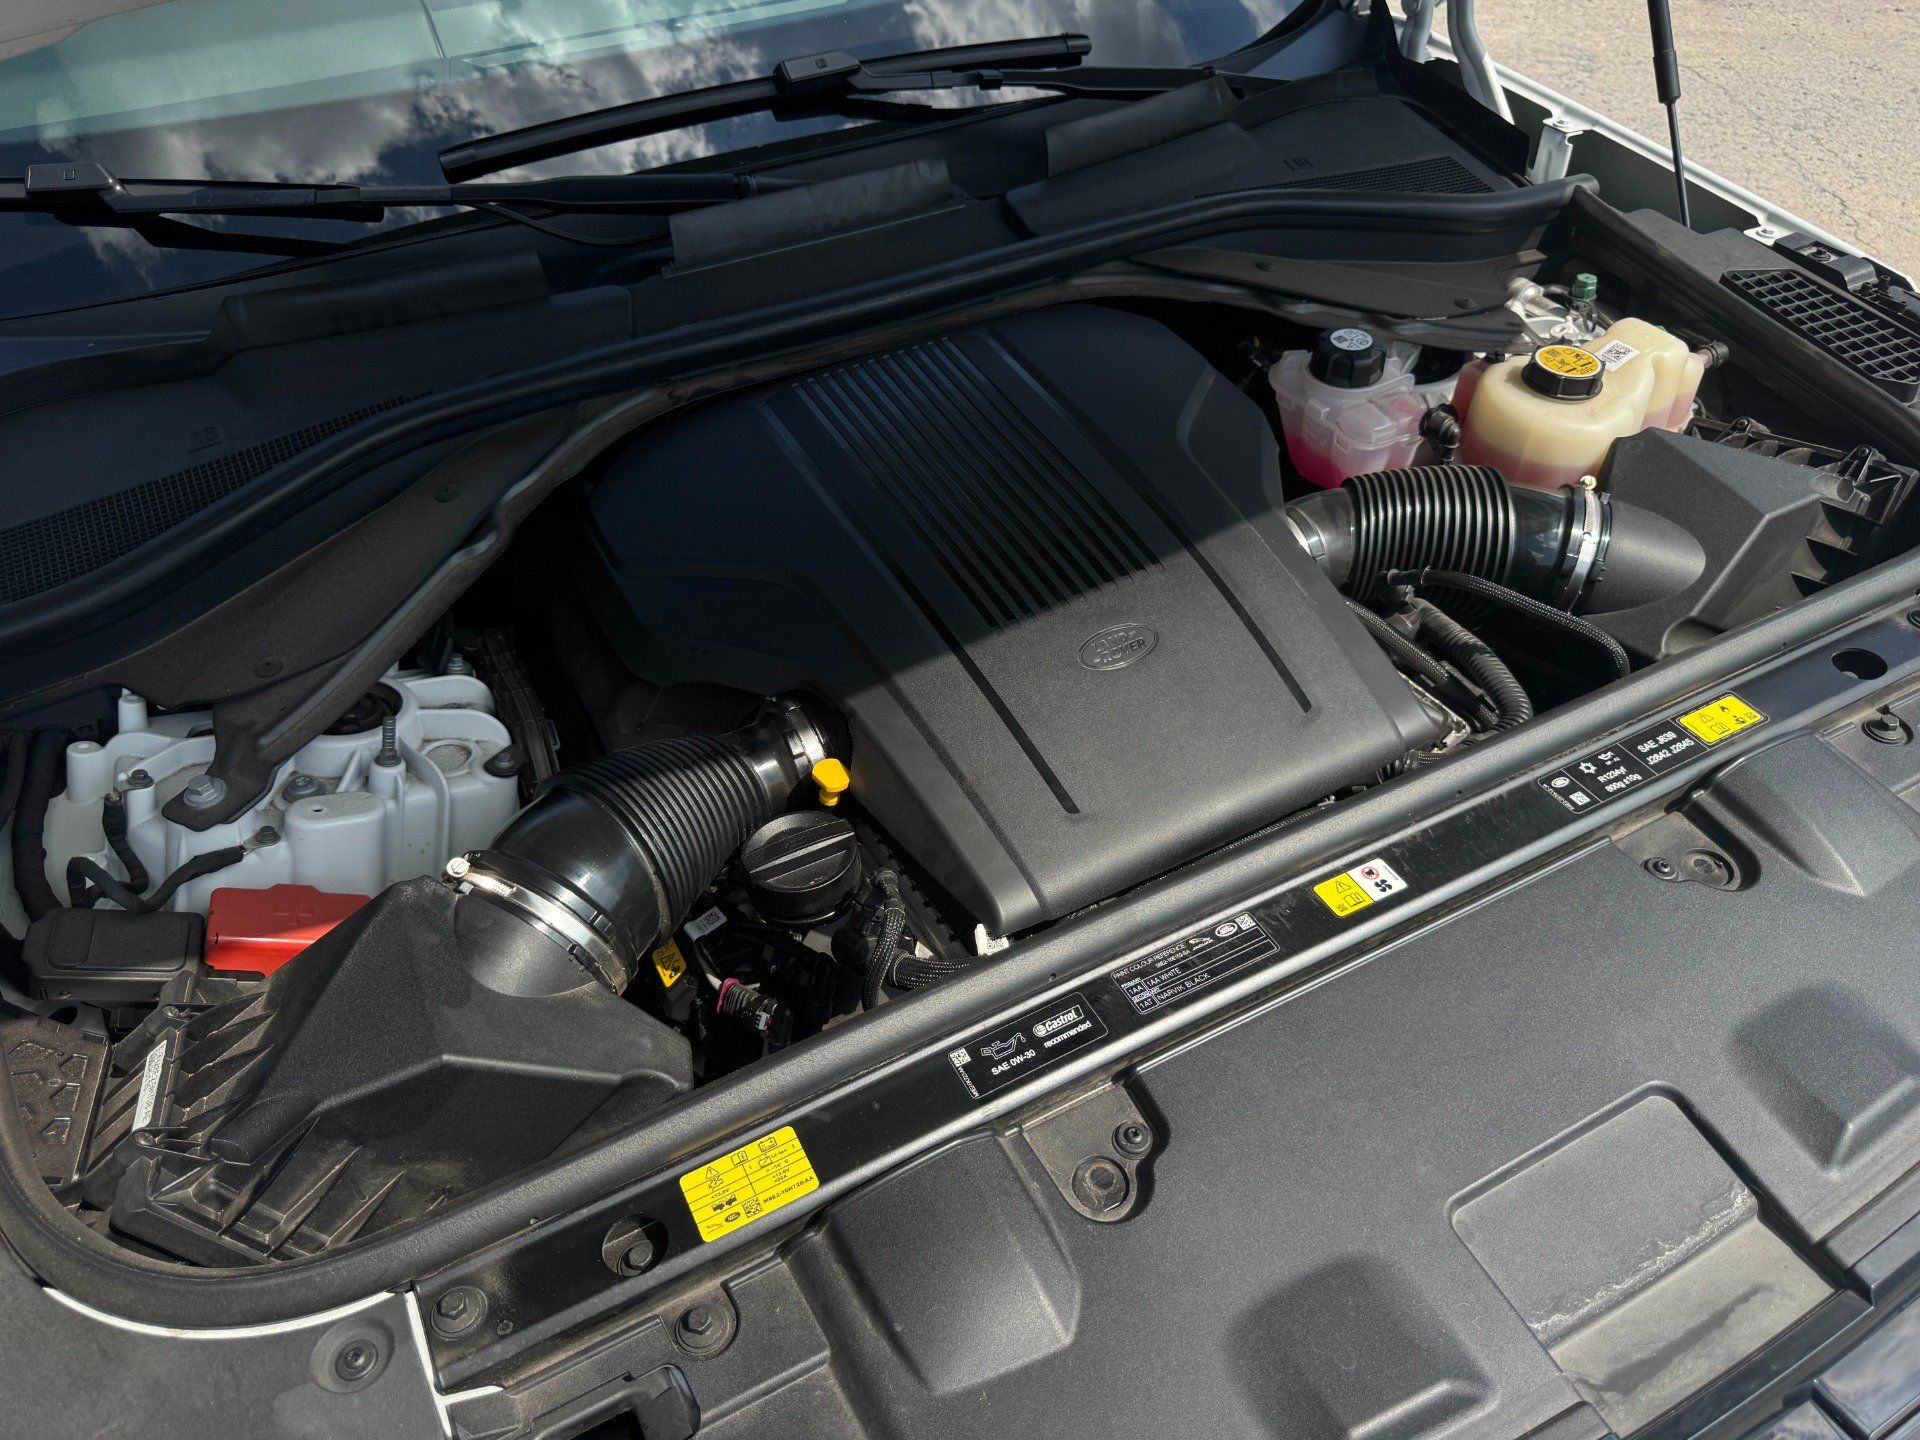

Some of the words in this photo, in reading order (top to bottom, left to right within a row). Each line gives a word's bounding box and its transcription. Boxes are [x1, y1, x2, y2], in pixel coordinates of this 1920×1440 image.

[1637, 740, 1659, 752] SAE
[1656, 731, 1677, 744] J639
[1646, 750, 1672, 765] J2842
[1669, 738, 1695, 753] J2845
[1113, 968, 1130, 979] PAINT
[1129, 958, 1154, 971] COLOUR
[1153, 943, 1186, 960] REFERENCE
[1146, 977, 1160, 987] 1AA
[1159, 967, 1181, 981] WHITE
[1156, 985, 1185, 1000] NARVIK
[1185, 972, 1211, 988] BLACK
[1129, 985, 1144, 995] 1AA
[1139, 998, 1153, 1009] 1AT
[1045, 1009, 1078, 1032] Castrol
[1043, 1020, 1092, 1048] recommended
[991, 1061, 1010, 1075] SAE
[1009, 1049, 1036, 1066] 0W-30
